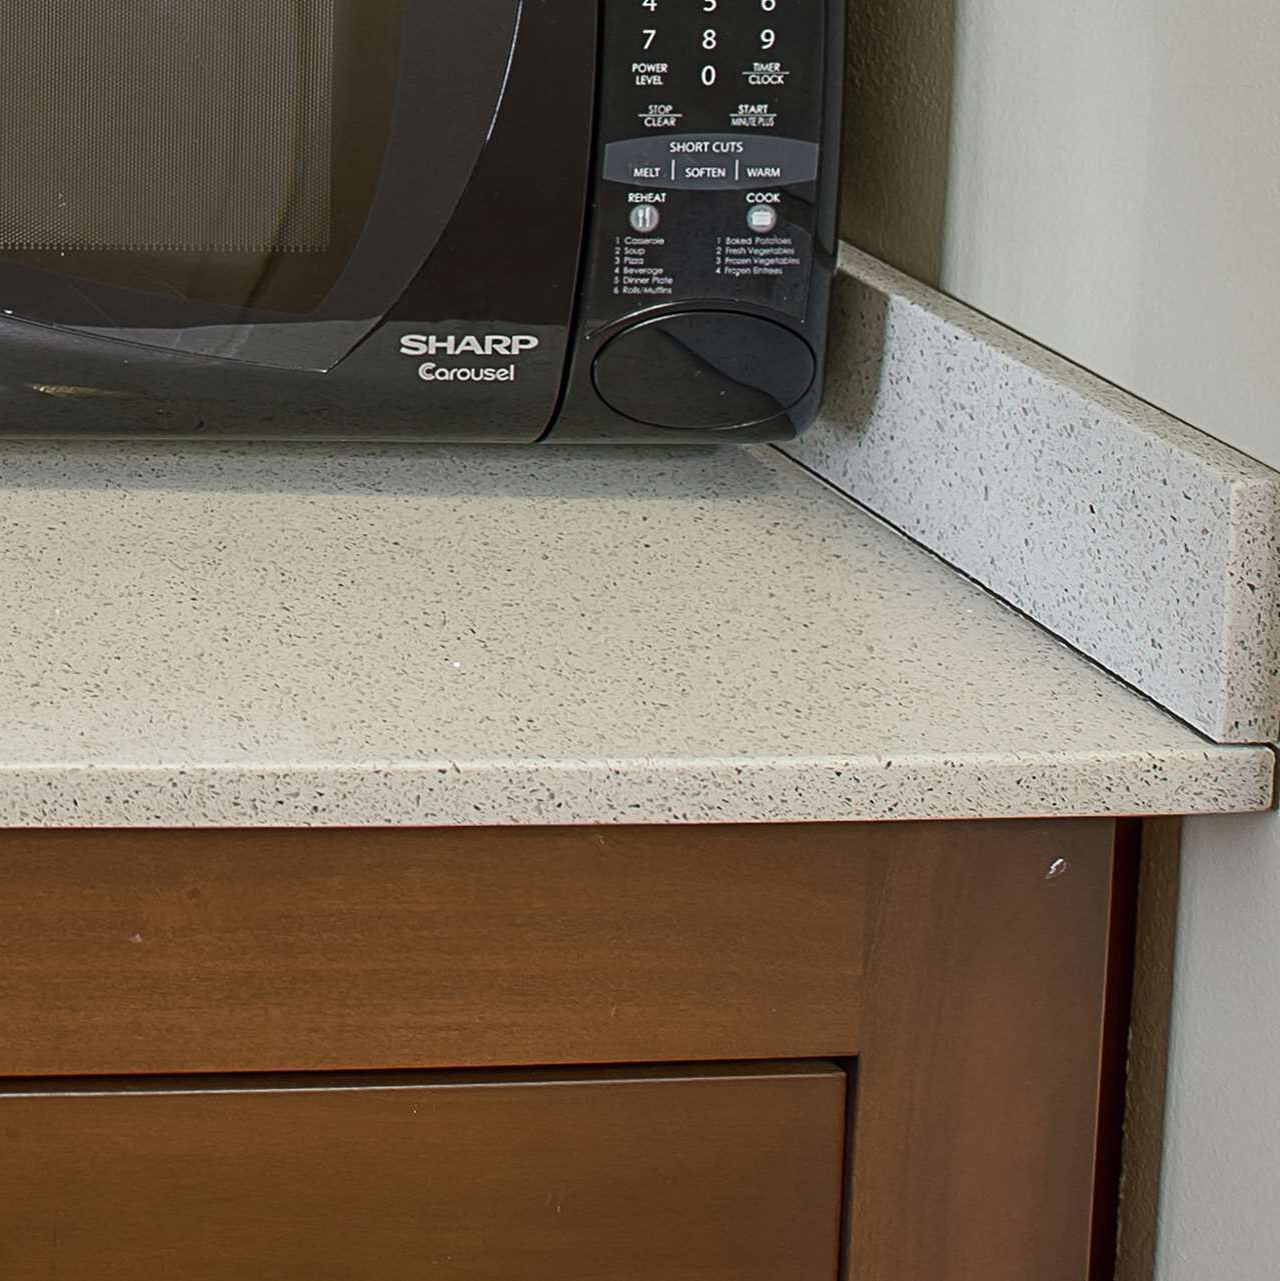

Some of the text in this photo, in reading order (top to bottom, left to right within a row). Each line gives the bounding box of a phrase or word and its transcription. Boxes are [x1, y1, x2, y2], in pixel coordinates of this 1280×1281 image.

[643, 30, 656, 49] 7
[702, 29, 716, 49] 8
[760, 29, 775, 49] 9
[632, 64, 668, 73] POWER
[753, 63, 781, 72] TIMER
[636, 75, 663, 85] LEVEL
[702, 65, 716, 86] 0
[748, 75, 784, 84] CLOCK
[648, 105, 672, 114] STOP
[738, 104, 769, 114] START
[644, 117, 676, 127] CLEAR
[670, 142, 743, 152] SHORT CUTS
[634, 168, 661, 177] MELT
[685, 168, 726, 177] SOFTEN
[747, 168, 780, 177] WARM
[628, 193, 667, 202] REHEAT
[746, 193, 780, 202] COOK
[400, 334, 539, 355] SHARP
[418, 362, 514, 381] Carousel
